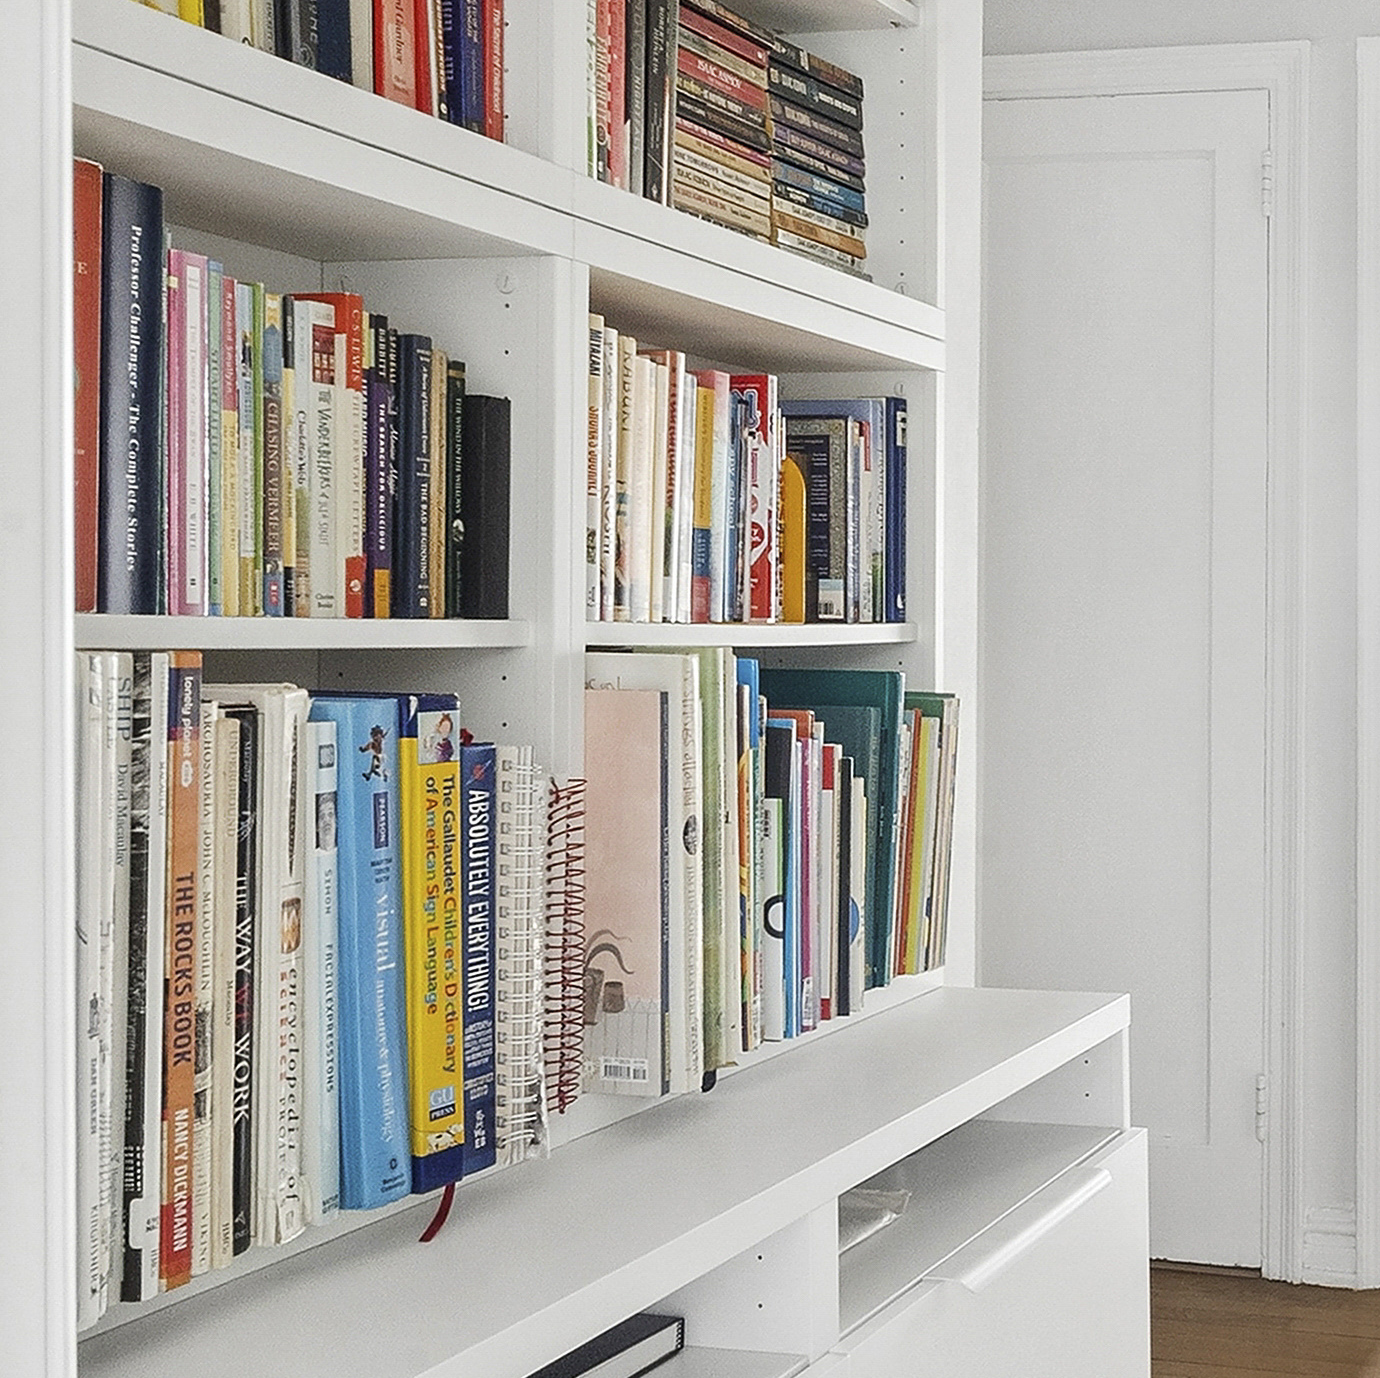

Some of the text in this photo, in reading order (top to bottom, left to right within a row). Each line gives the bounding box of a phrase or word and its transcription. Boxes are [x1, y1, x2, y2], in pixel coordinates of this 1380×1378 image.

[393, 14, 405, 65] Gardner
[493, 8, 501, 27] The
[658, 6, 666, 45] ROBERT
[438, 41, 446, 91] PYNCHON
[493, 63, 502, 113] Childhood
[596, 35, 608, 123] FAHRENHEIT
[633, 76, 641, 154] NIGHTFALL
[225, 292, 233, 394] Raymond Smullyan
[389, 334, 398, 385] SPINELLI
[589, 328, 602, 377] MIYAZAKI
[125, 224, 143, 573] Professor Challenger The Complete Stories
[319, 389, 330, 404] THE
[621, 350, 633, 433] KABUKI
[267, 402, 280, 553] CHASING VERMEER
[297, 410, 307, 485] Charlotte's Web
[351, 417, 359, 552] SCREWTAPE LETTERS
[454, 397, 462, 515] THE WIND IN THE WILLOWS
[378, 494, 386, 551] DELICIOUS
[419, 482, 428, 580] THE BAD BEGINNING
[181, 676, 194, 757] lonely planet
[115, 676, 132, 868] SHIP David Macaulay
[202, 711, 213, 870] ARCHOSAURIA JOHN
[226, 729, 238, 839] UNDERGROUND
[378, 797, 386, 843] PEARSON
[467, 790, 490, 896] ABSOLUTELY
[324, 868, 332, 916] SIMON
[423, 776, 440, 1015] of American Sign Language
[442, 774, 457, 1074] The Gallaudet Children's Dictionary
[173, 871, 195, 1067] THE ROCKS BOOK
[234, 870, 253, 1125] THE WAY WE WORK
[467, 902, 491, 1013] EVERYTHING!
[374, 893, 397, 1144] visual anatomy physiology
[287, 967, 300, 1202] encyclopedia of
[429, 1086, 454, 1105] GU
[173, 1108, 189, 1252] NANCY DICKMANN
[199, 1212, 208, 1266] VIKING
